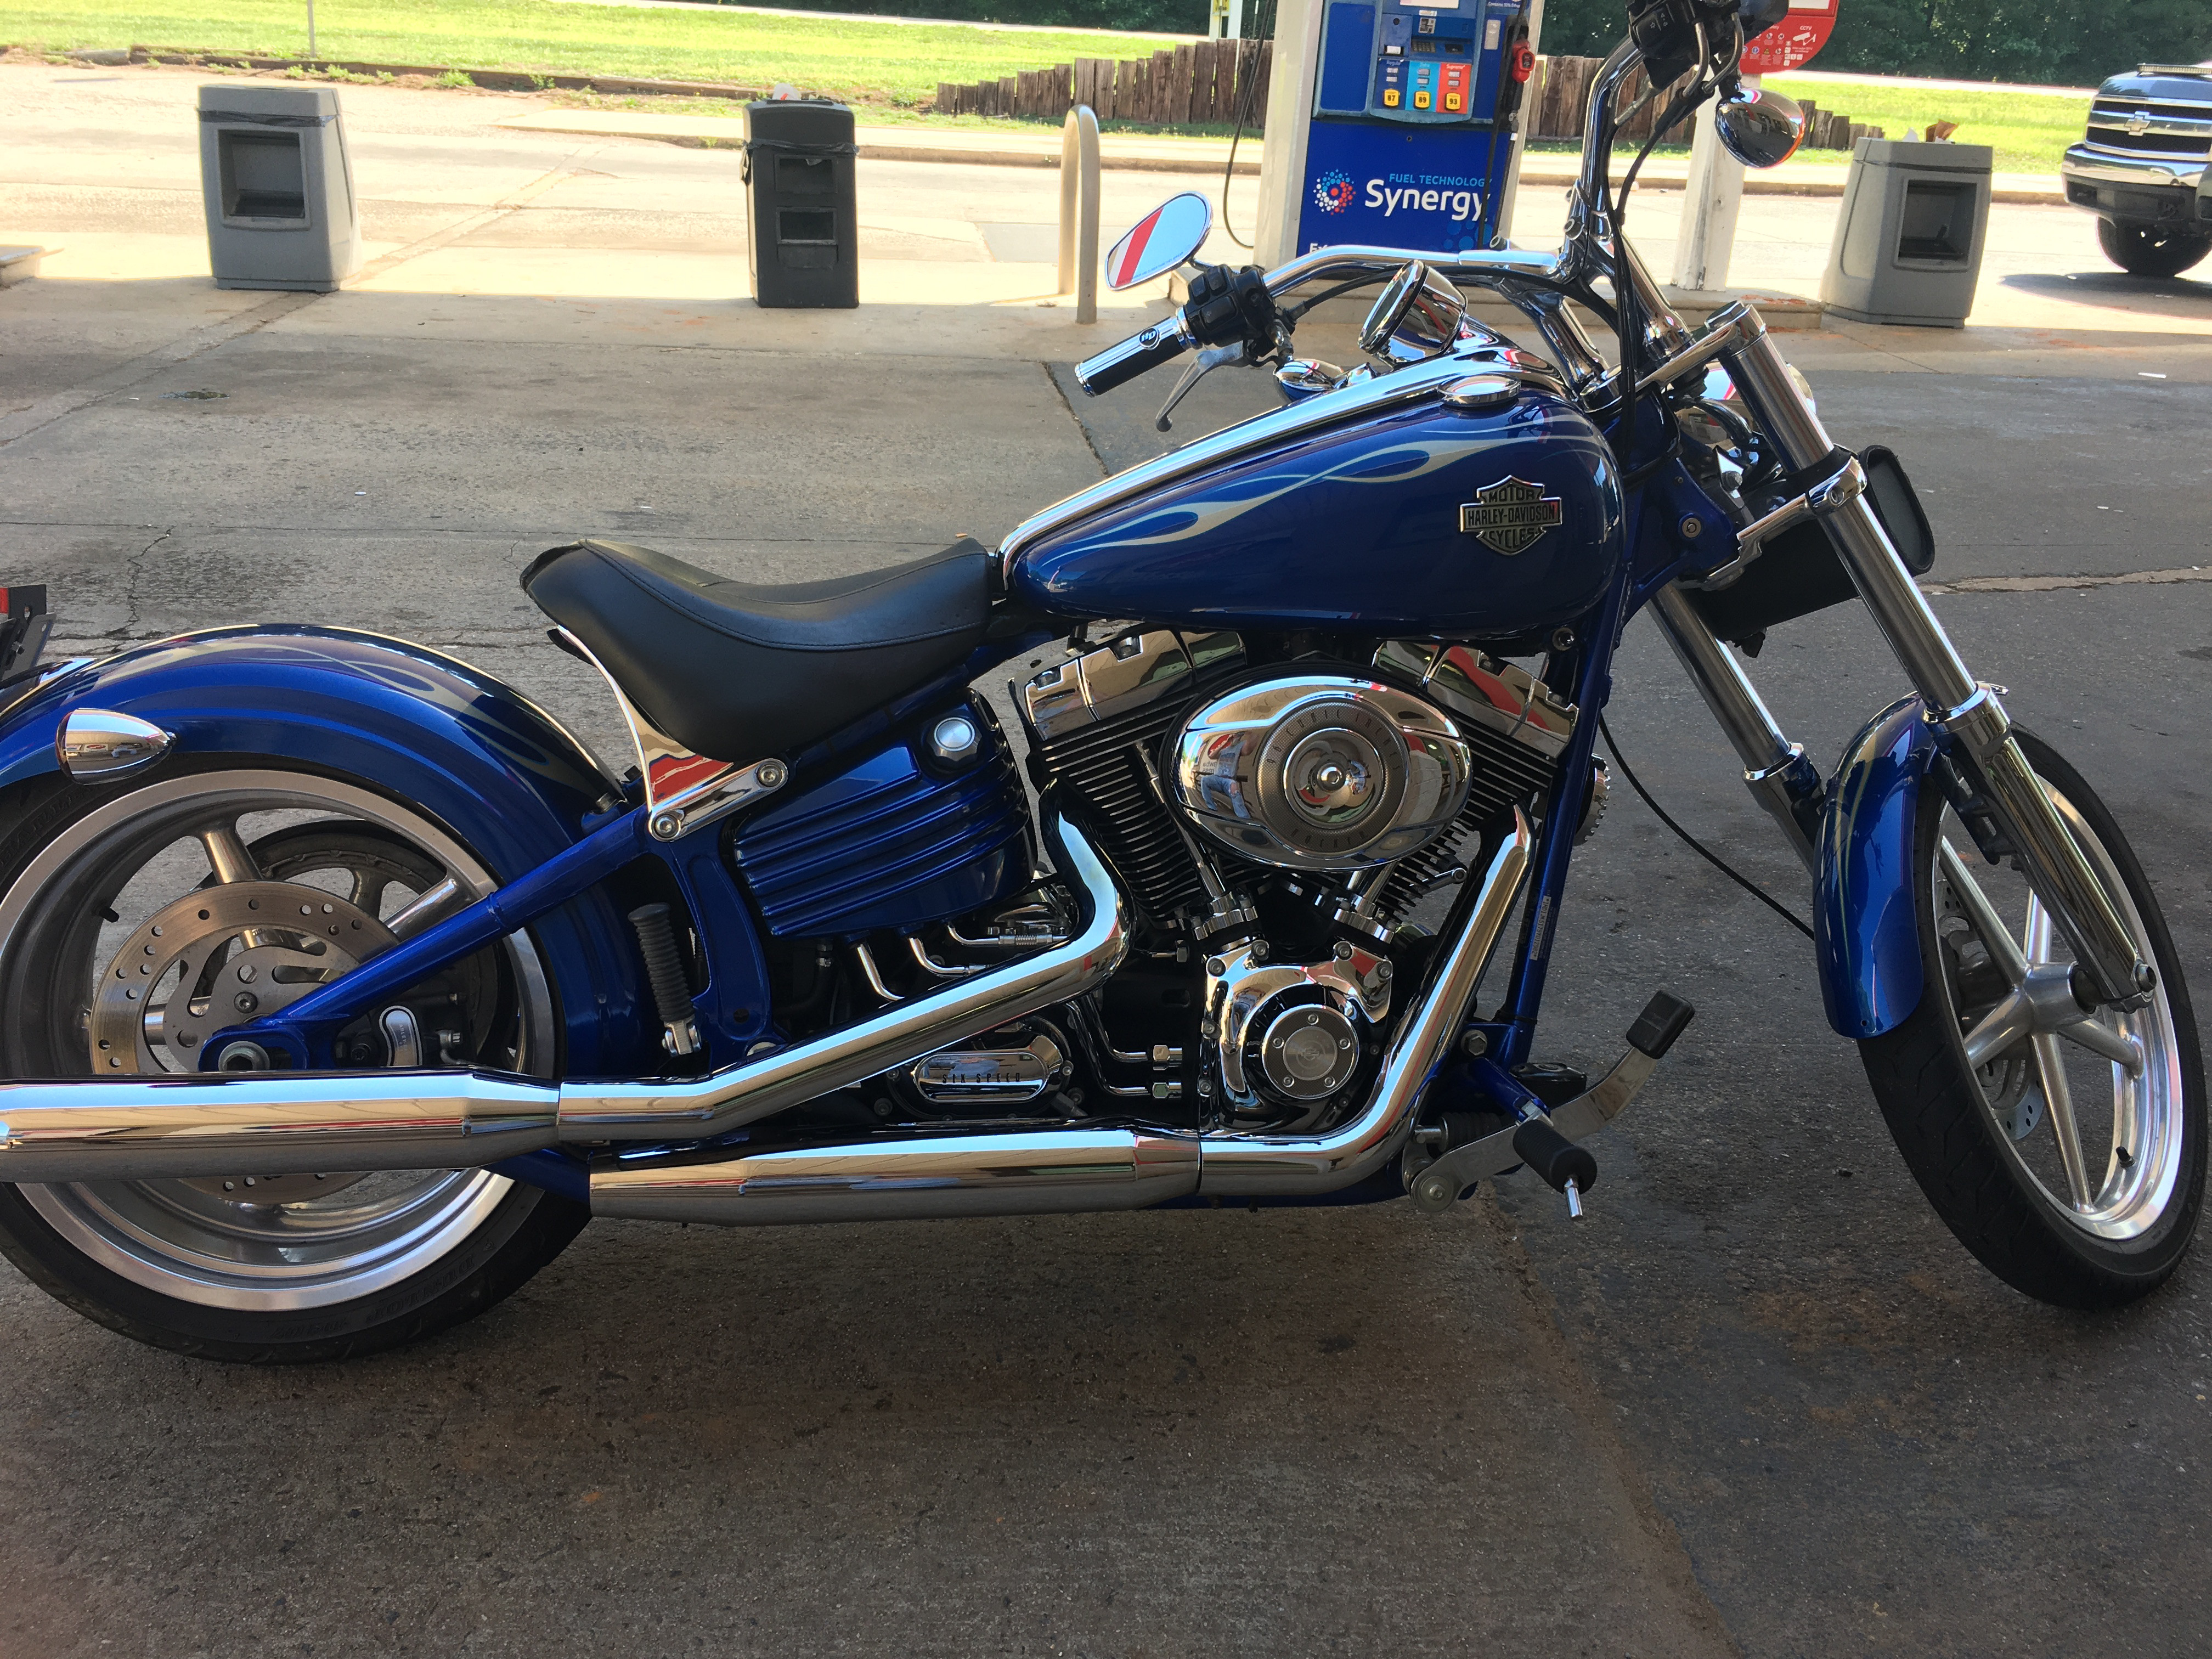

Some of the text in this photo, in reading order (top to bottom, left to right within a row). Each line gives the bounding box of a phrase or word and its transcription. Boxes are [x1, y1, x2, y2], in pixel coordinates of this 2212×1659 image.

[1389, 173, 1492, 188] FUEL TECHNOLOG
[1364, 179, 1491, 222] Synergy
[1488, 484, 1534, 503] MOTOR
[1468, 504, 1556, 527] HARLEY-DAVIDSON
[1488, 527, 1535, 549] CYCLES
[942, 1072, 1020, 1084] SIX SPEED
